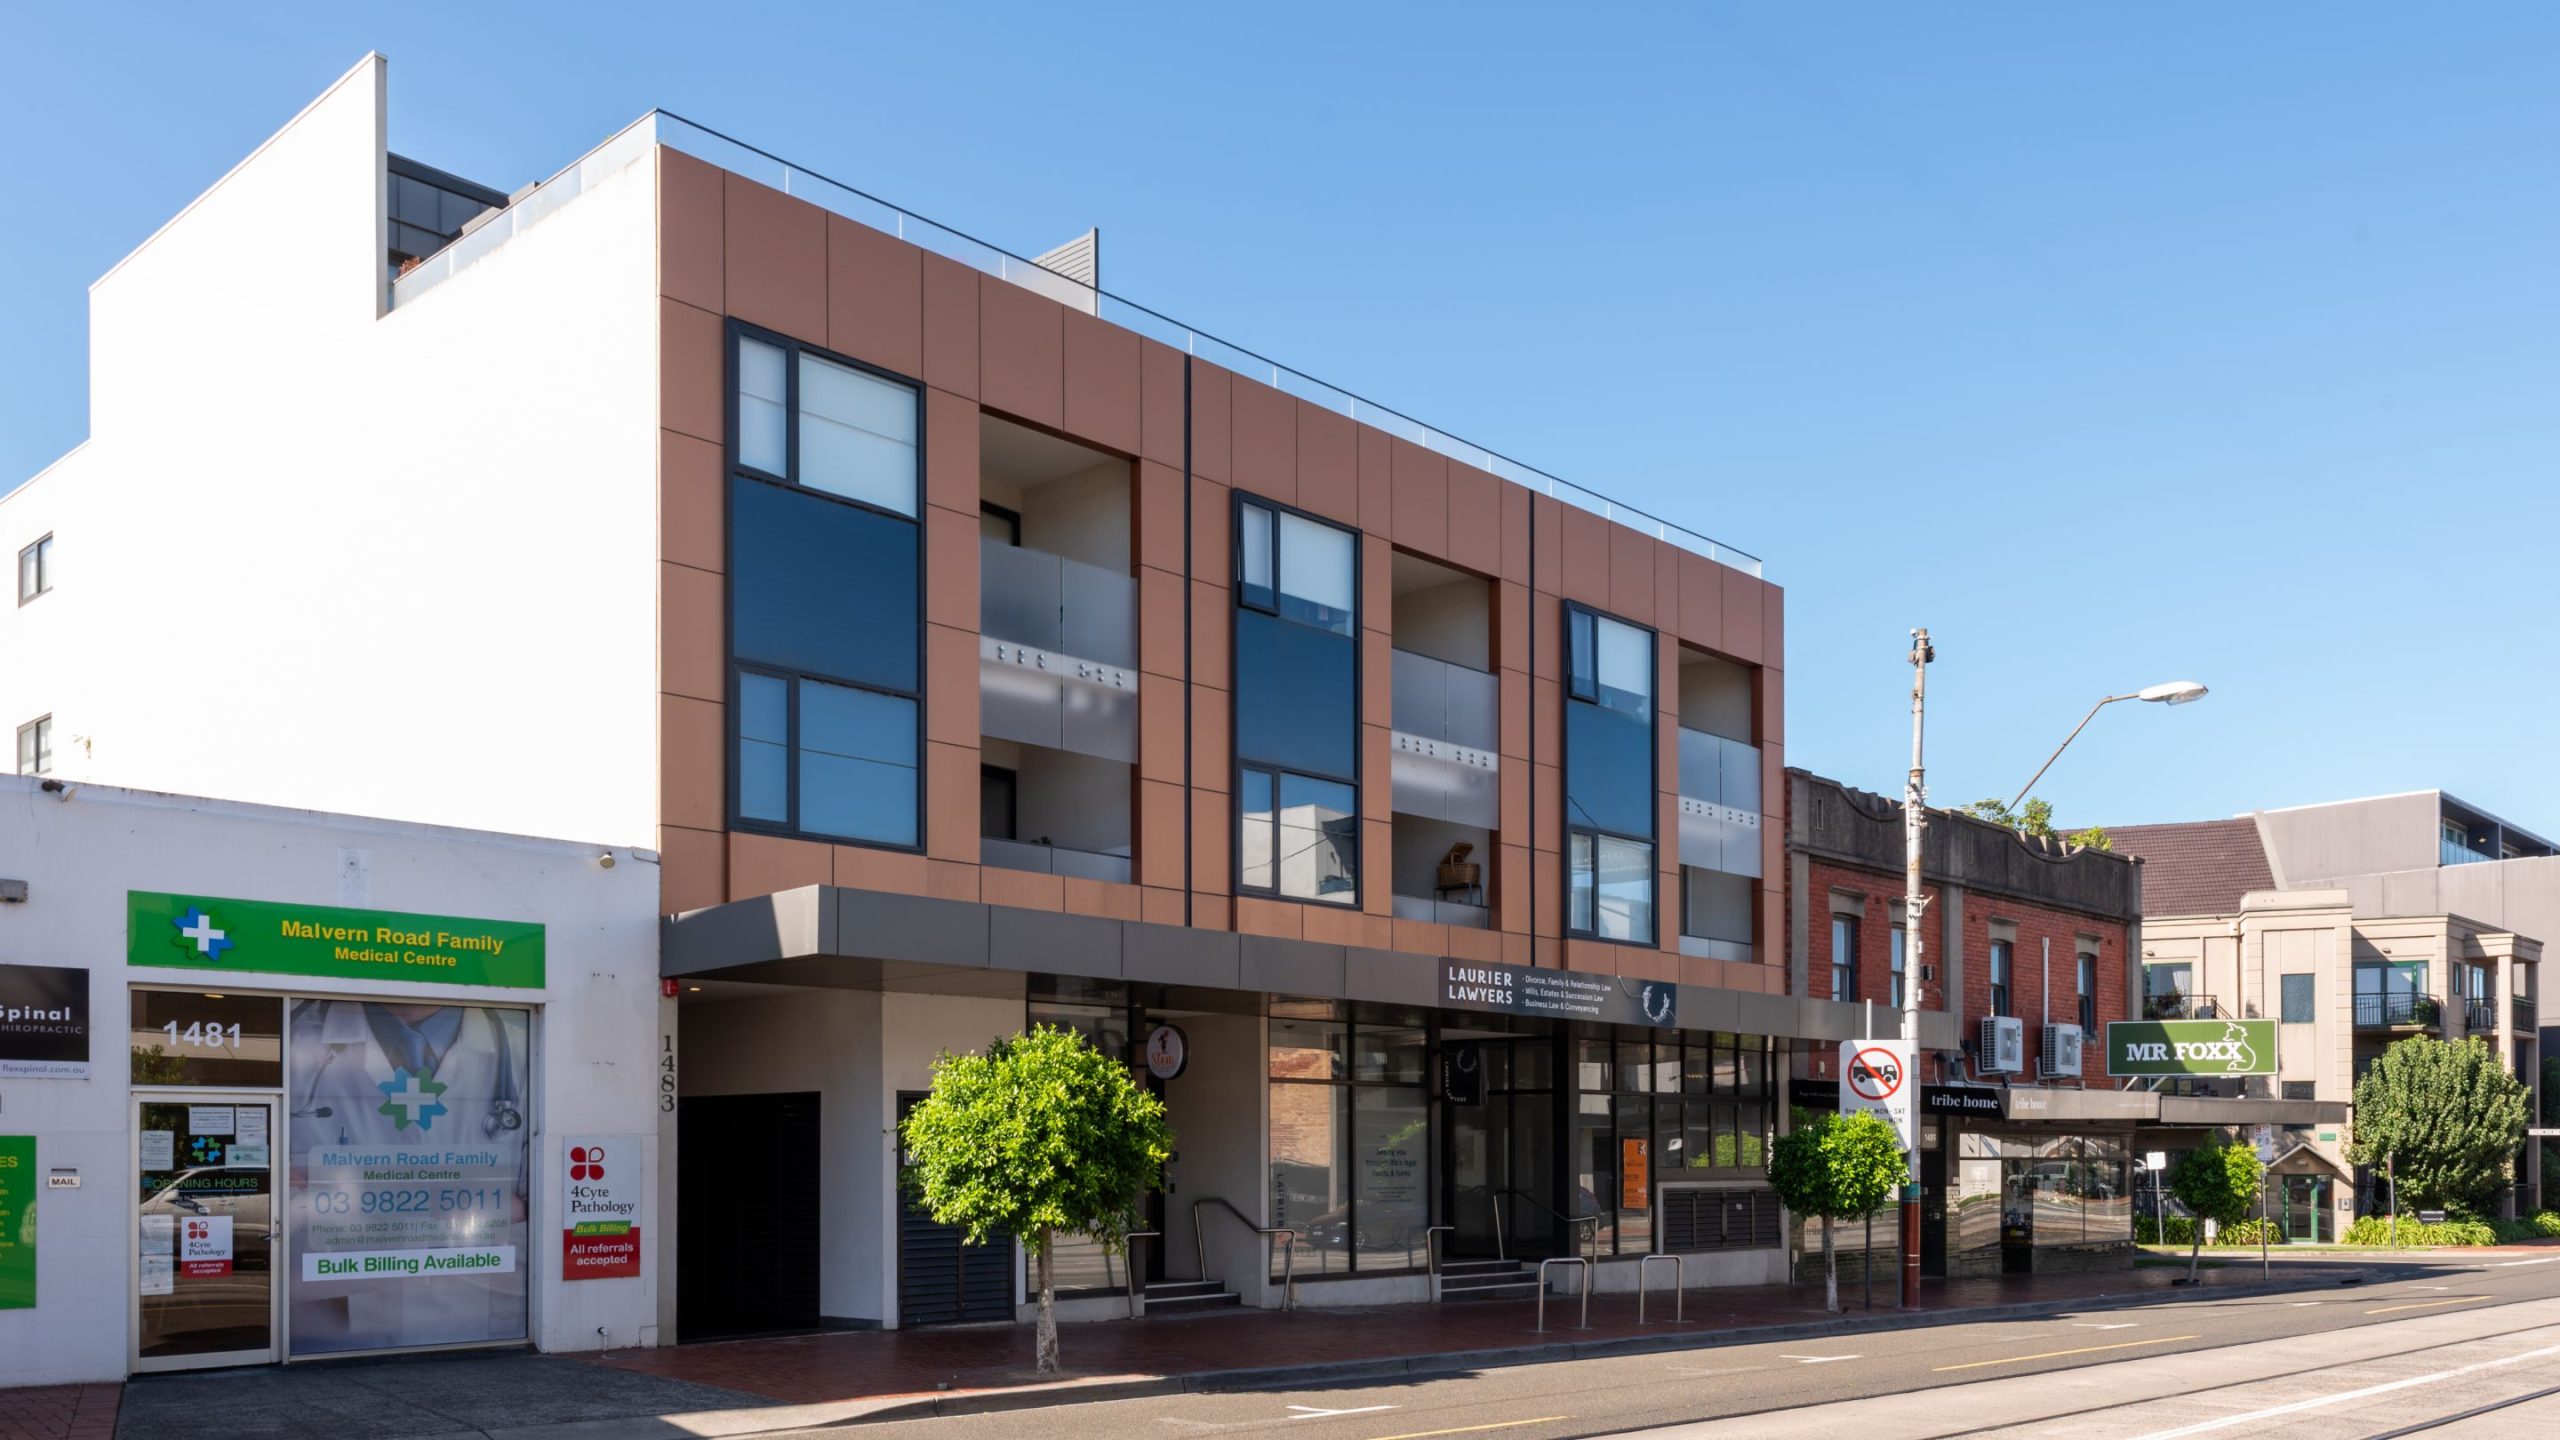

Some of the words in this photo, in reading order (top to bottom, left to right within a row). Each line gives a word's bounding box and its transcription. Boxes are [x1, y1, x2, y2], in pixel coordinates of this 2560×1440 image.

[281, 919, 369, 943] Malvern
[376, 927, 431, 947] Road
[437, 932, 504, 956] Family
[335, 946, 399, 963] Medical
[403, 951, 457, 967] Centre
[1448, 966, 1513, 987] LAURIER
[1525, 975, 1547, 985] Divorce,
[1548, 977, 1564, 987] Family
[1570, 980, 1600, 991] Relationship
[1602, 984, 1611, 992] Law
[1448, 985, 1513, 1005] LAWYERS
[1541, 989, 1559, 998] Estates
[1565, 991, 1592, 1001] Succession
[1594, 994, 1604, 1002] Law
[1525, 998, 1548, 1008] Business
[1549, 1001, 1558, 1009] Law
[1565, 1002, 1599, 1015] Conveyancing
[163, 1020, 241, 1048] 1481
[2126, 1043, 2169, 1061] MR
[2174, 1041, 2243, 1060] FOXX
[661, 1035, 676, 1113] 1483
[1931, 1094, 1960, 1107] tribe
[1963, 1095, 1998, 1109] home
[322, 1152, 391, 1167] Malvern
[396, 1152, 440, 1166] Road
[445, 1152, 498, 1167] Family
[52, 1178, 77, 1186] MAIL
[215, 1177, 258, 1188] HOURS
[363, 1169, 414, 1181] Medical
[418, 1169, 461, 1181] Centre
[571, 1186, 610, 1200] 4Cyte
[315, 1191, 350, 1215] 03
[361, 1189, 430, 1214] 9822
[440, 1188, 501, 1212] 5011
[571, 1200, 635, 1214] Pathology
[576, 1223, 597, 1233] Bulk
[599, 1223, 628, 1234] Billing
[188, 1240, 211, 1249] 4Cyte
[188, 1248, 225, 1256] Pathology
[570, 1244, 585, 1255] All
[587, 1243, 634, 1254] referrals
[318, 1258, 359, 1274] Bulk
[364, 1256, 419, 1274] Billing
[424, 1253, 501, 1269] Available
[576, 1255, 628, 1267] accepted
[192, 1267, 222, 1275] accepted
